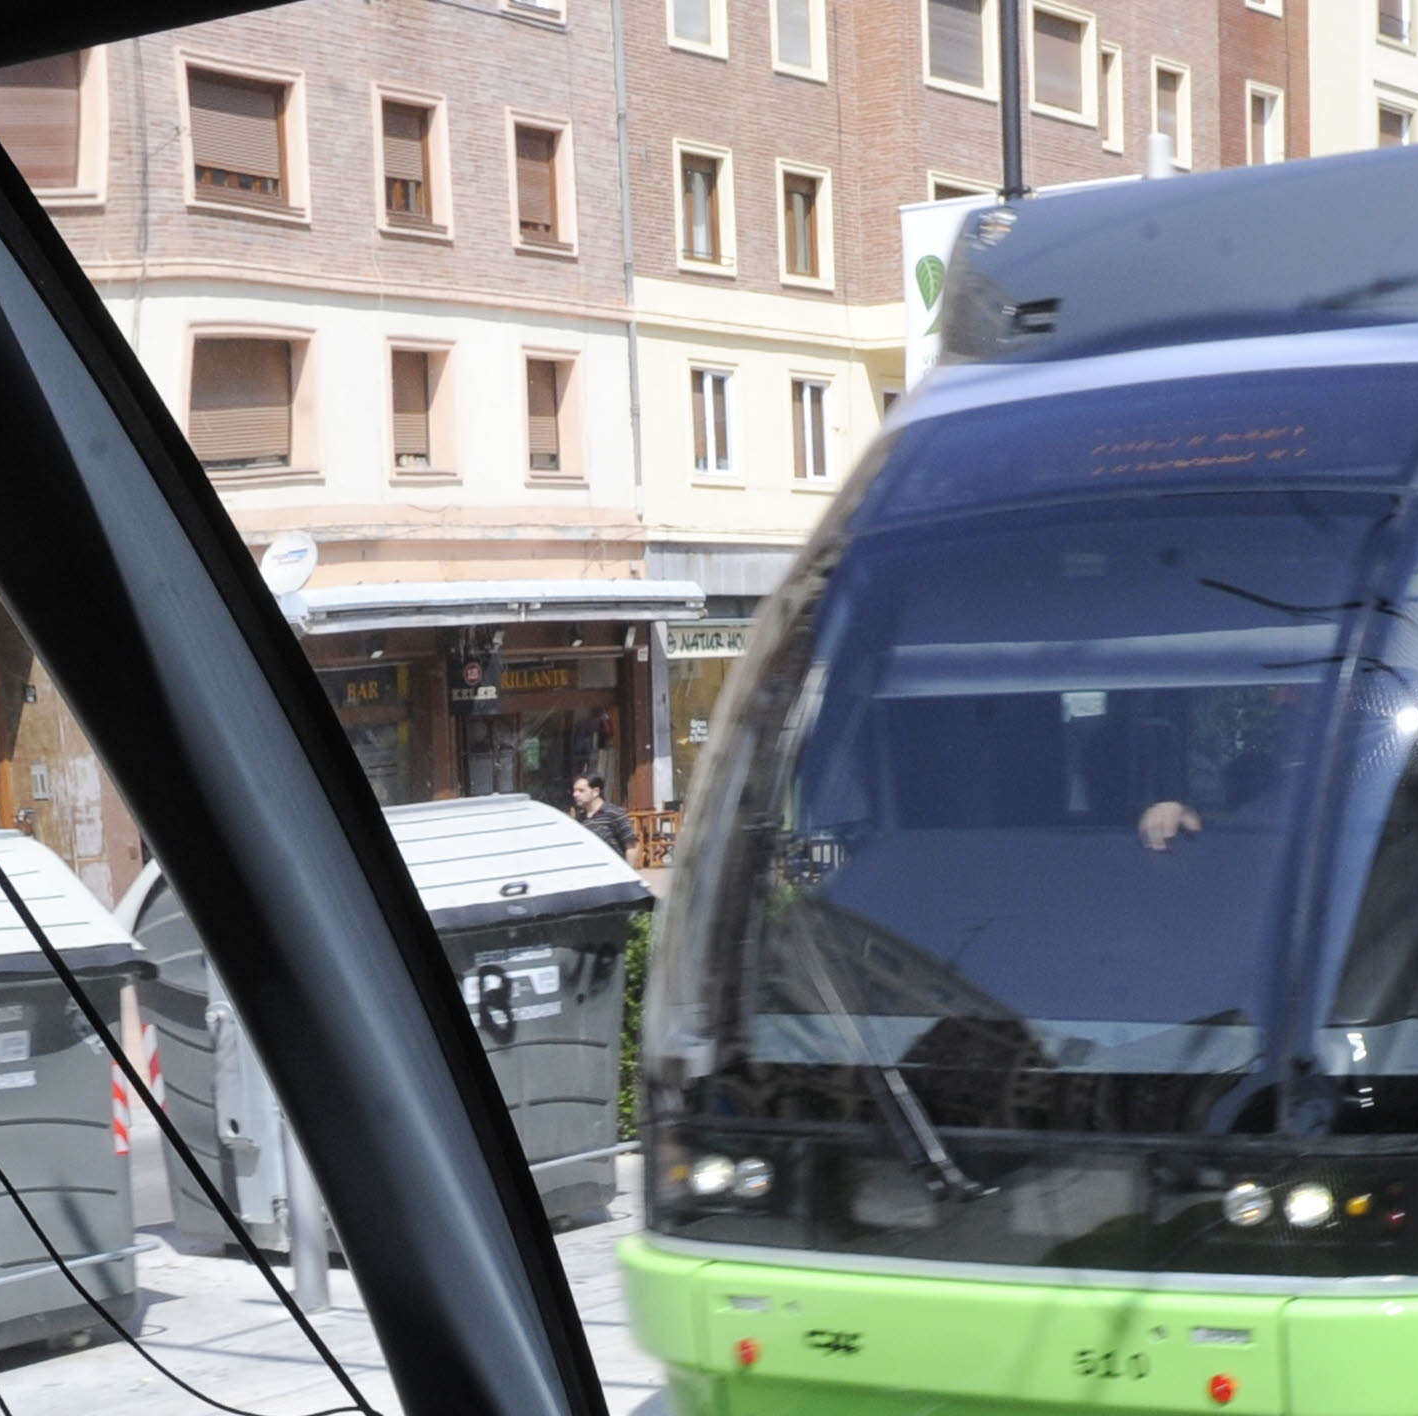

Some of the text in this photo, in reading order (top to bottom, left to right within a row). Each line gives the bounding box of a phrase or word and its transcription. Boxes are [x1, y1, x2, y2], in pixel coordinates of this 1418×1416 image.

[679, 632, 746, 653] NATUR HO
[501, 669, 570, 690] RILLANTE
[347, 681, 380, 701] BAR
[1074, 1349, 1152, 1381] 510
